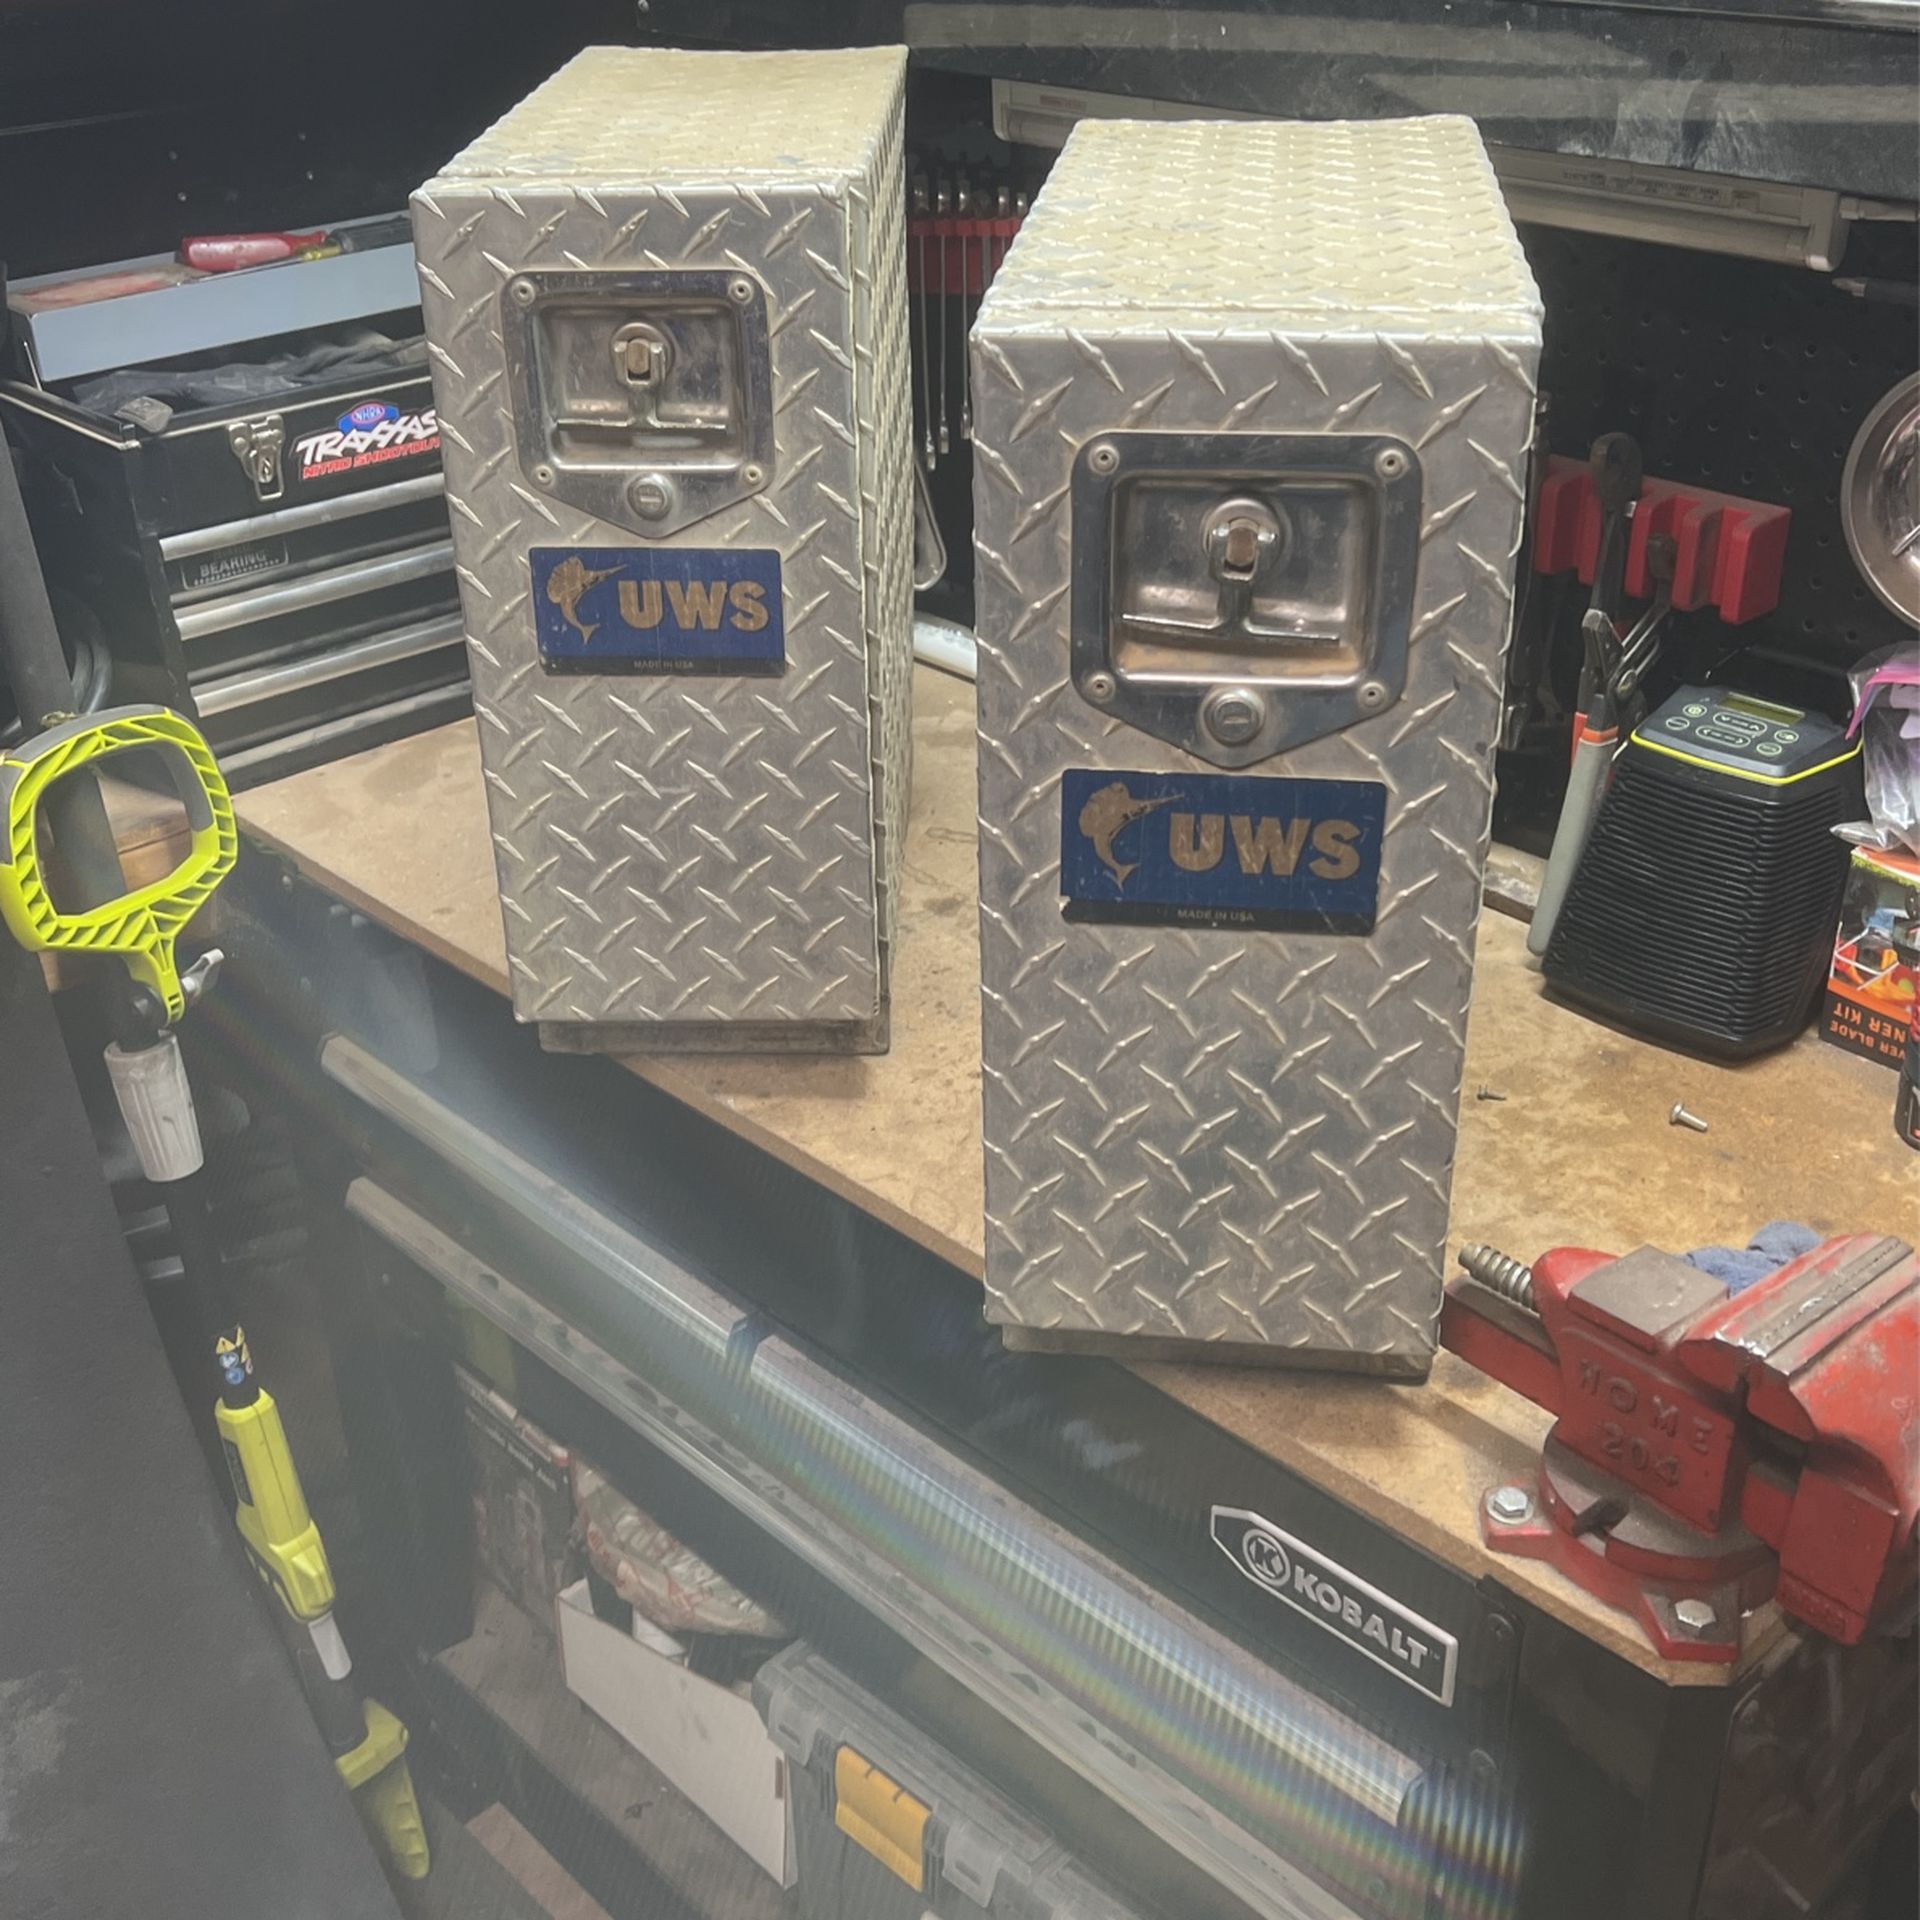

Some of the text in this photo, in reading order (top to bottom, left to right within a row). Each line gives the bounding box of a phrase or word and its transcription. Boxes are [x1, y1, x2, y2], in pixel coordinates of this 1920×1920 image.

[296, 409, 439, 465] TRAXXAS
[303, 456, 351, 480] NITRO
[200, 553, 267, 577] BEARING
[617, 580, 769, 632] UWS
[633, 659, 694, 669] MADE IN USA
[1169, 813, 1361, 880] UWS
[1177, 909, 1256, 922] MADE IN USA
[1829, 1020, 1875, 1048] BLADE
[1833, 1002, 1906, 1043] NER KIT
[1579, 1358, 1714, 1456] HOME
[1601, 1421, 1680, 1487] 204
[1294, 1565, 1429, 1669] KOBALT
